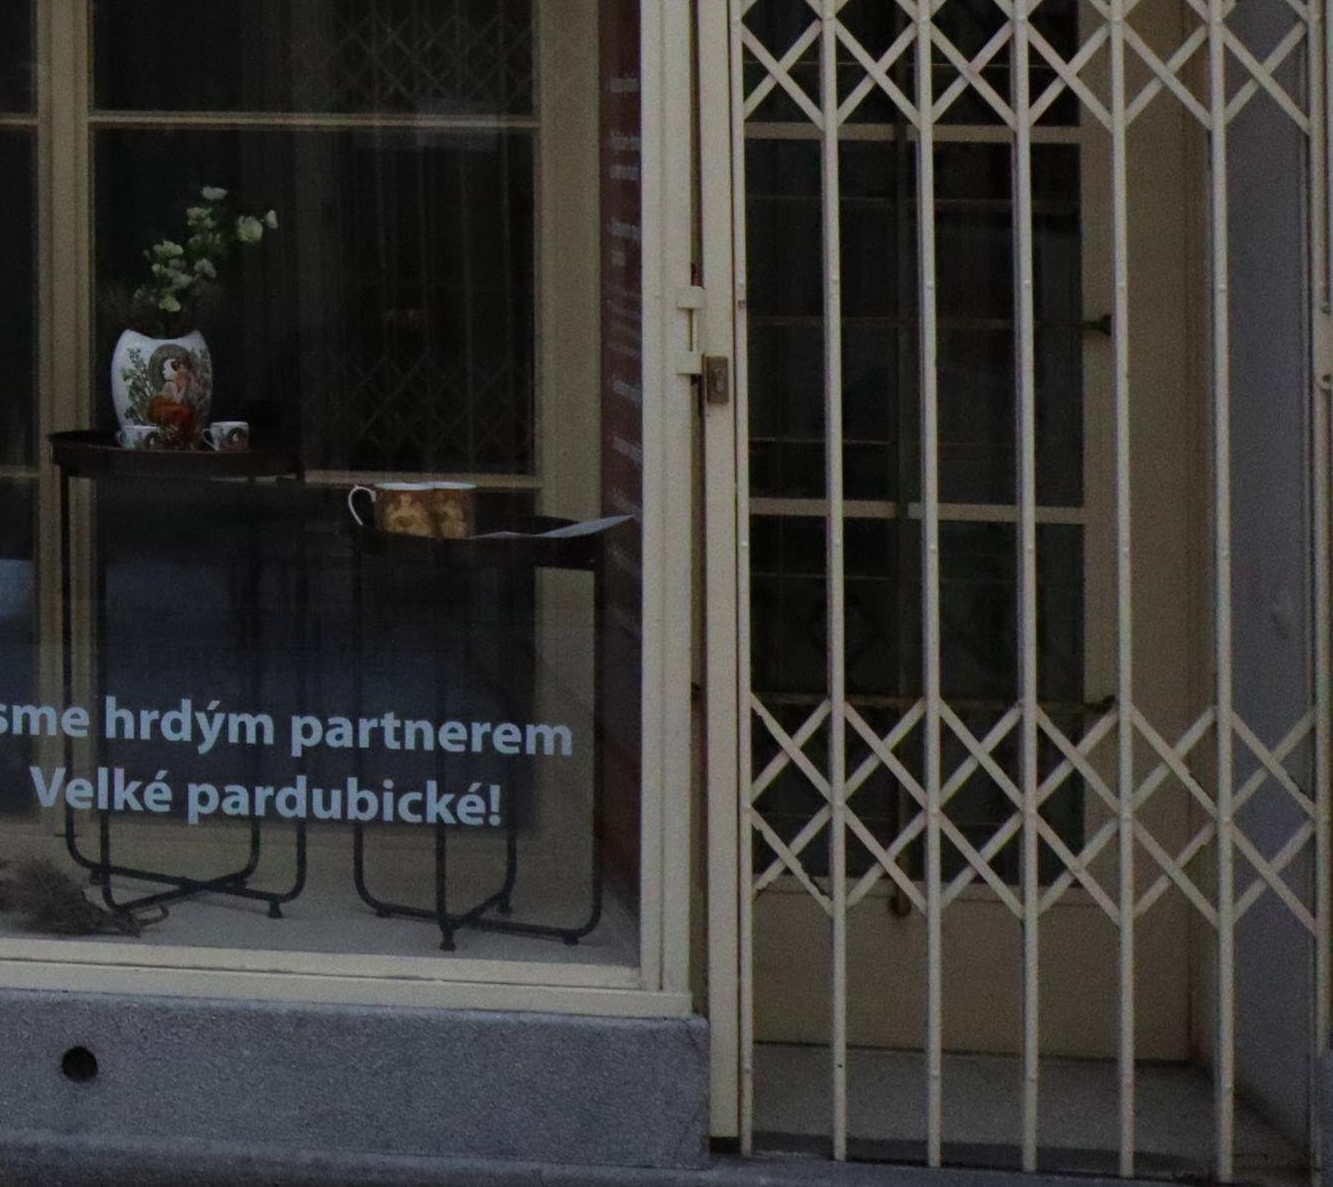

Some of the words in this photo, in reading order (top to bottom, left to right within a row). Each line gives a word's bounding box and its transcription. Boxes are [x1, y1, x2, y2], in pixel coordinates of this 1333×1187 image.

[104, 696, 274, 755] hrdým
[291, 712, 573, 757] partnerem
[30, 766, 172, 813] Velké
[188, 776, 503, 826] pardubické!
